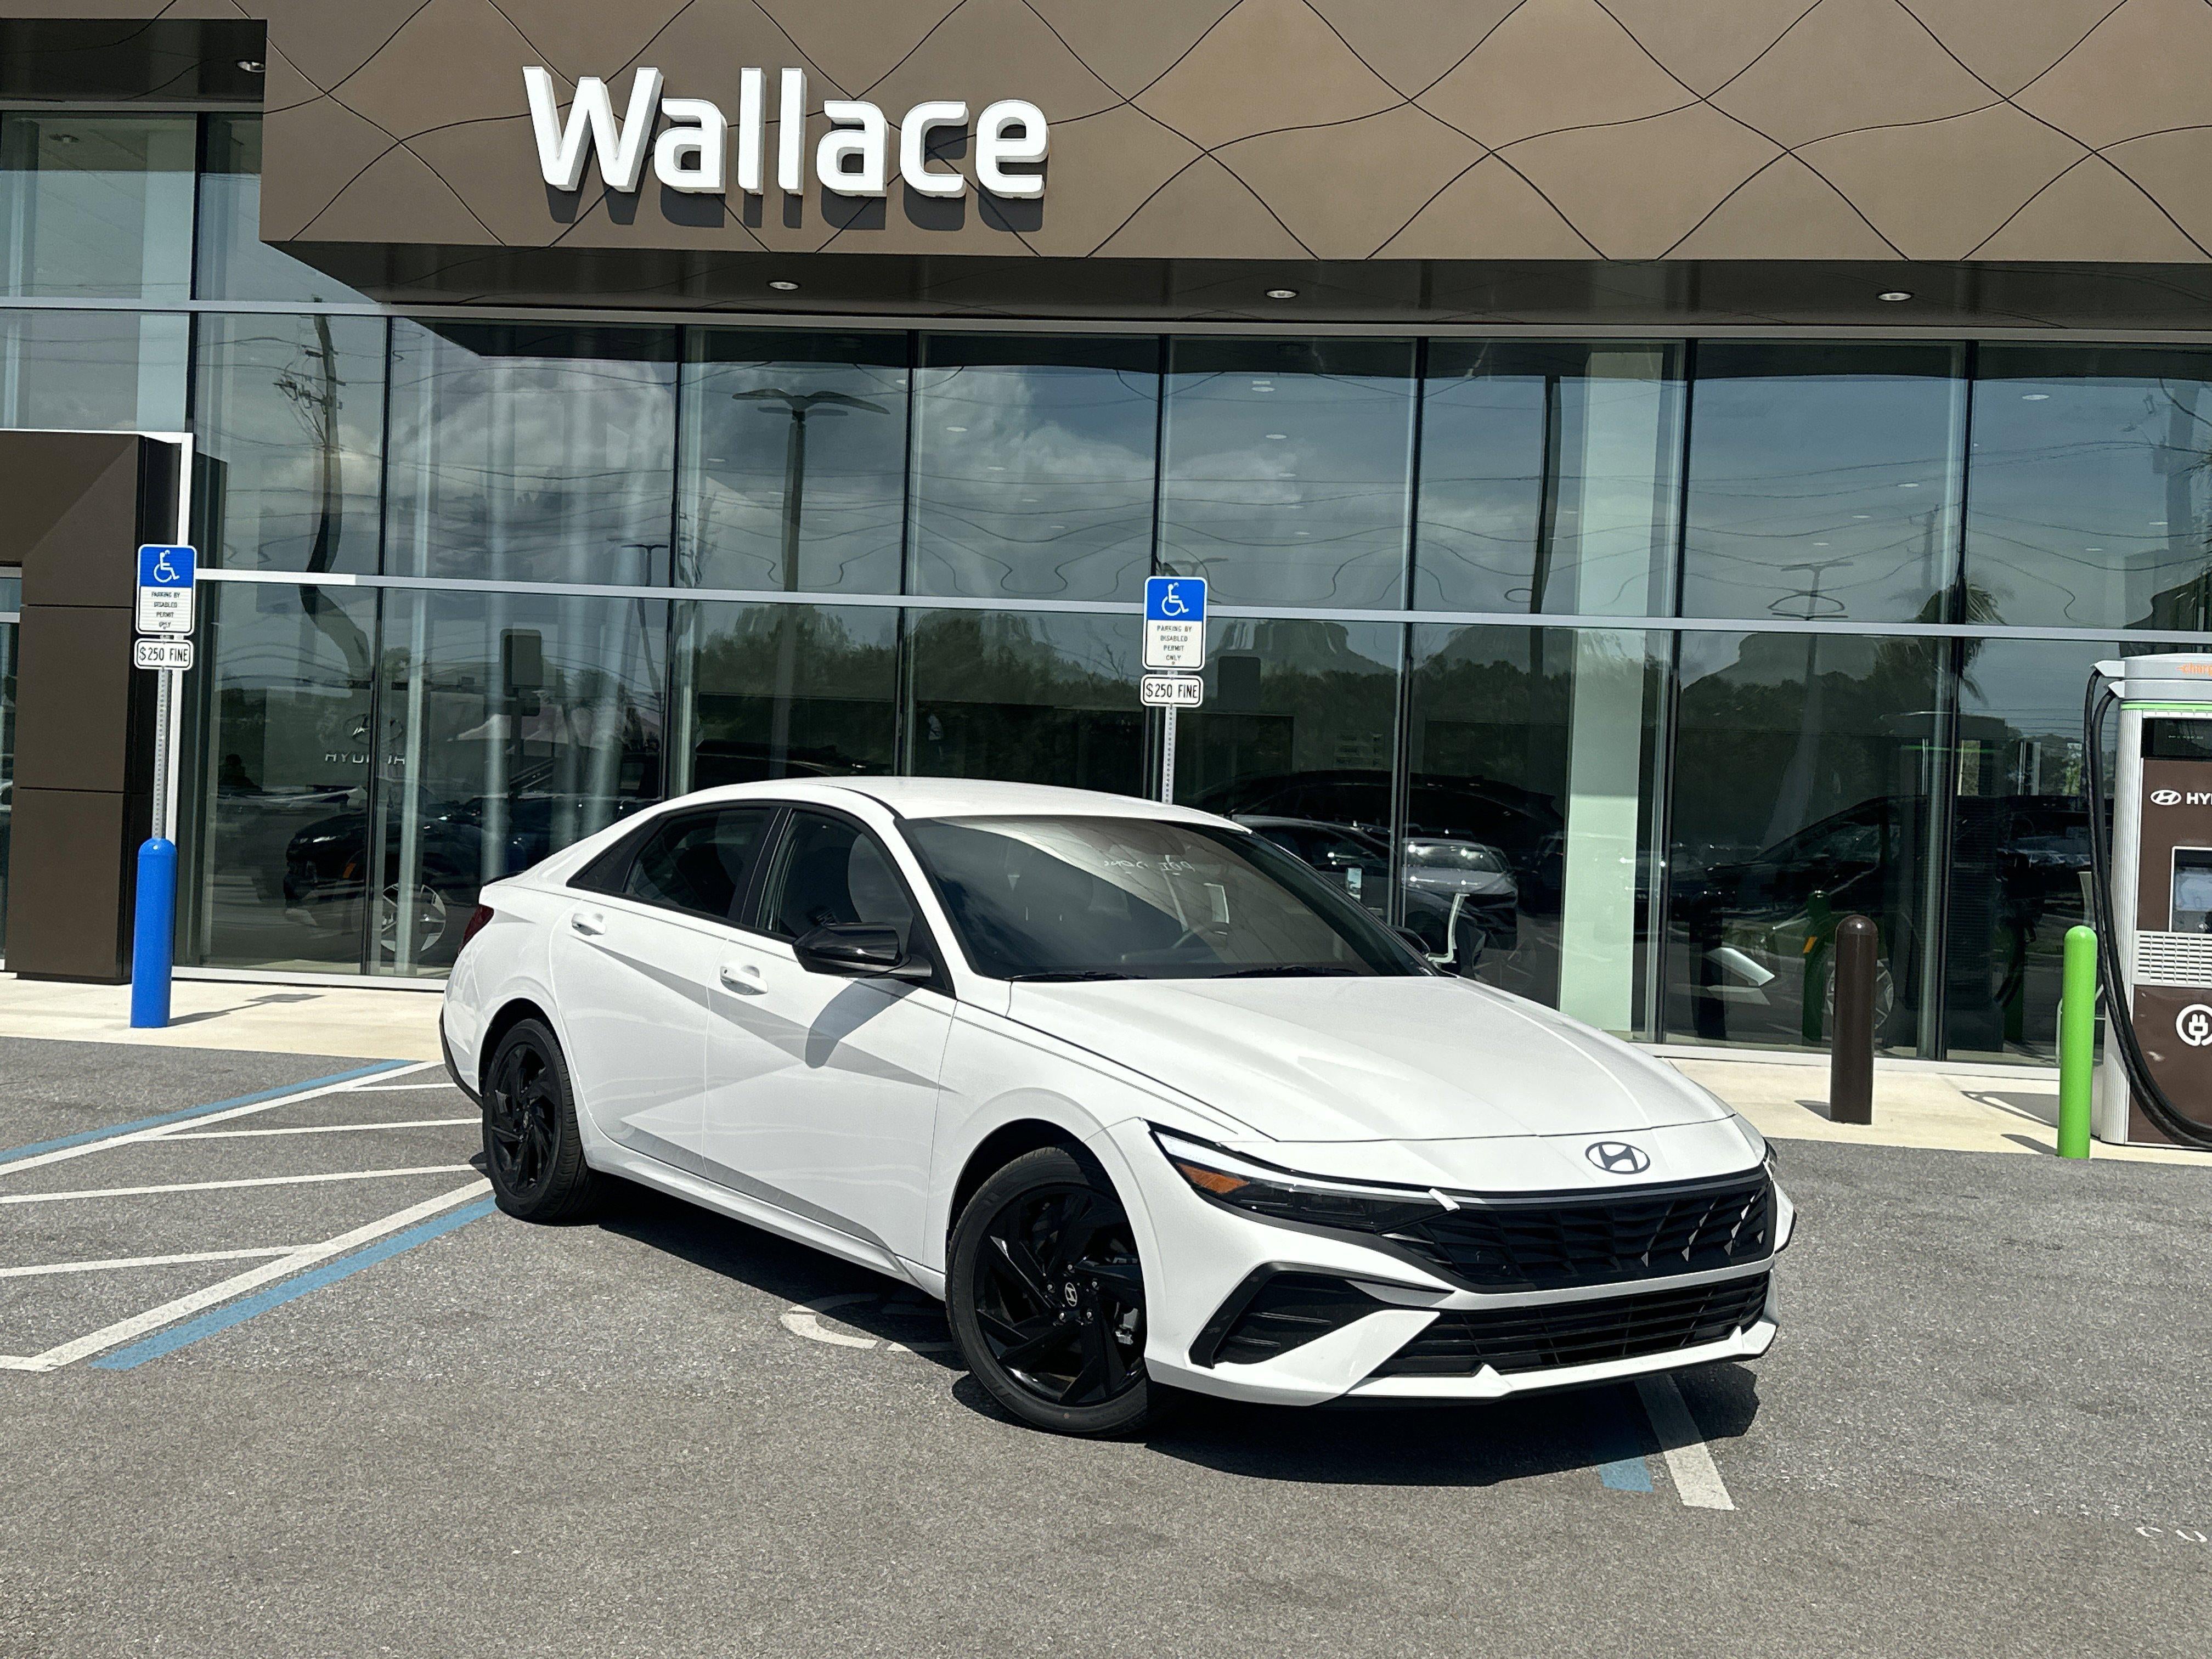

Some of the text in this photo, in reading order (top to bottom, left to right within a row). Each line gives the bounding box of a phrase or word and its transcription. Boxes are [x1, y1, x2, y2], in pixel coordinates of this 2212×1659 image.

[522, 66, 1049, 199] Wallace
[139, 647, 188, 662] $250 FINE
[1146, 683, 1198, 698] $250 FINE
[2186, 792, 2212, 805] HY
